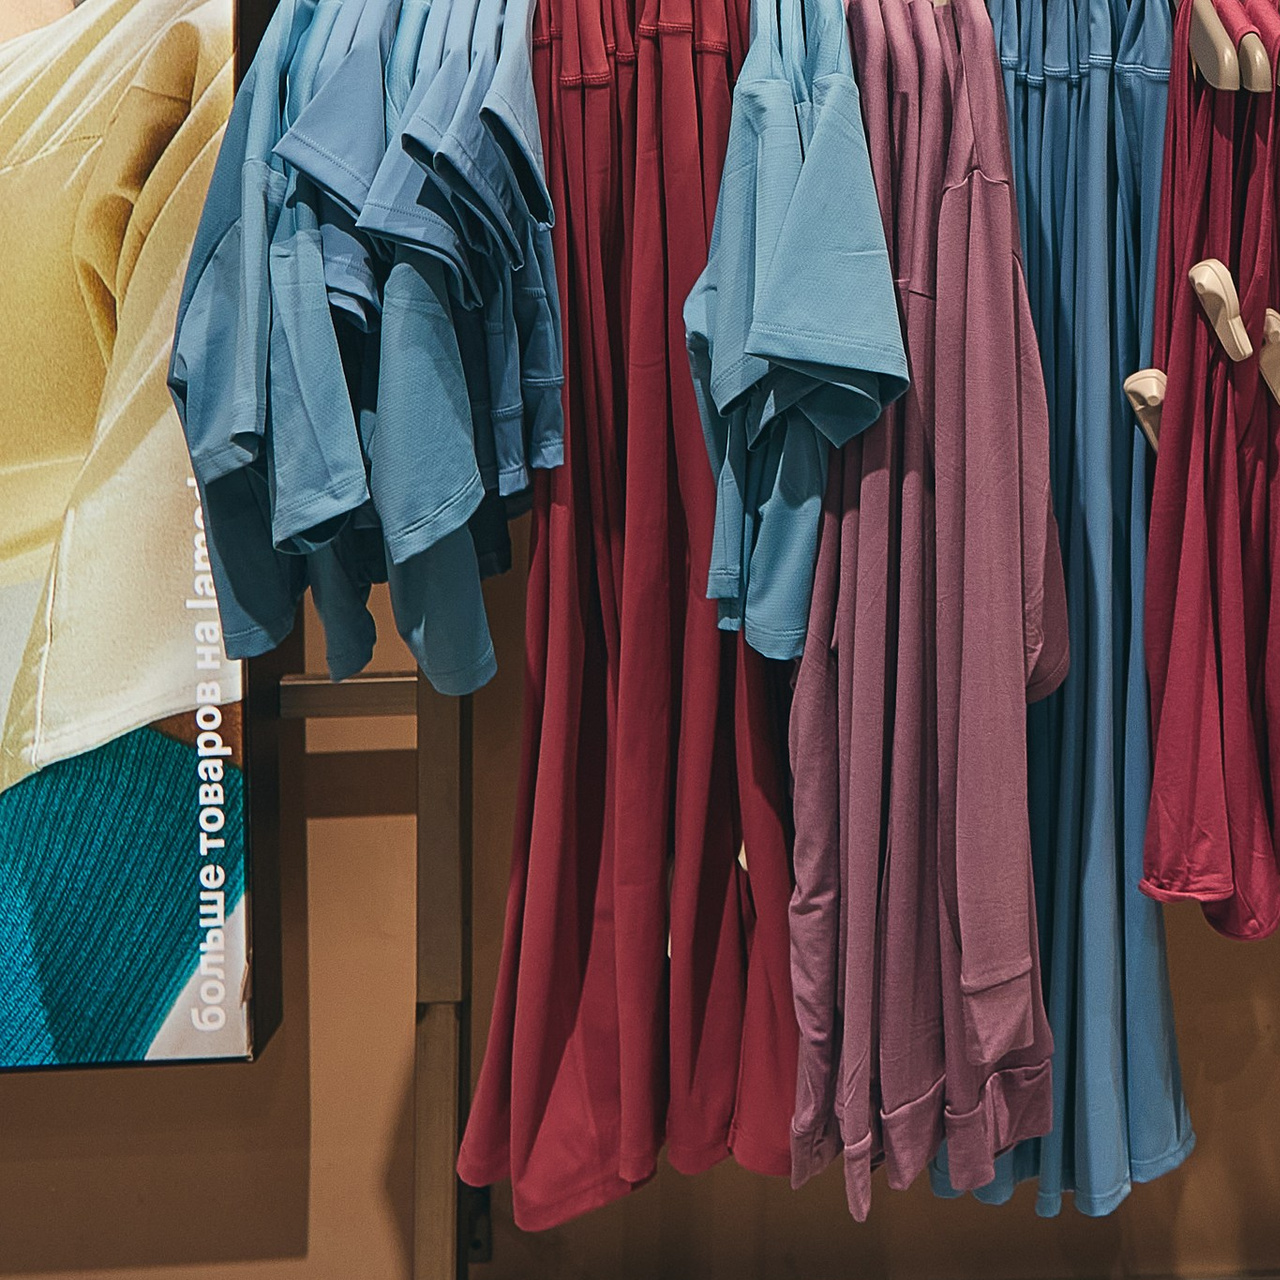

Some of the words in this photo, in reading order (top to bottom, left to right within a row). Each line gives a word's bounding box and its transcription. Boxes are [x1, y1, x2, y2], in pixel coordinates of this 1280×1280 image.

[194, 620, 221, 670] на
[196, 681, 232, 857] товаров
[190, 863, 226, 1032] больше
